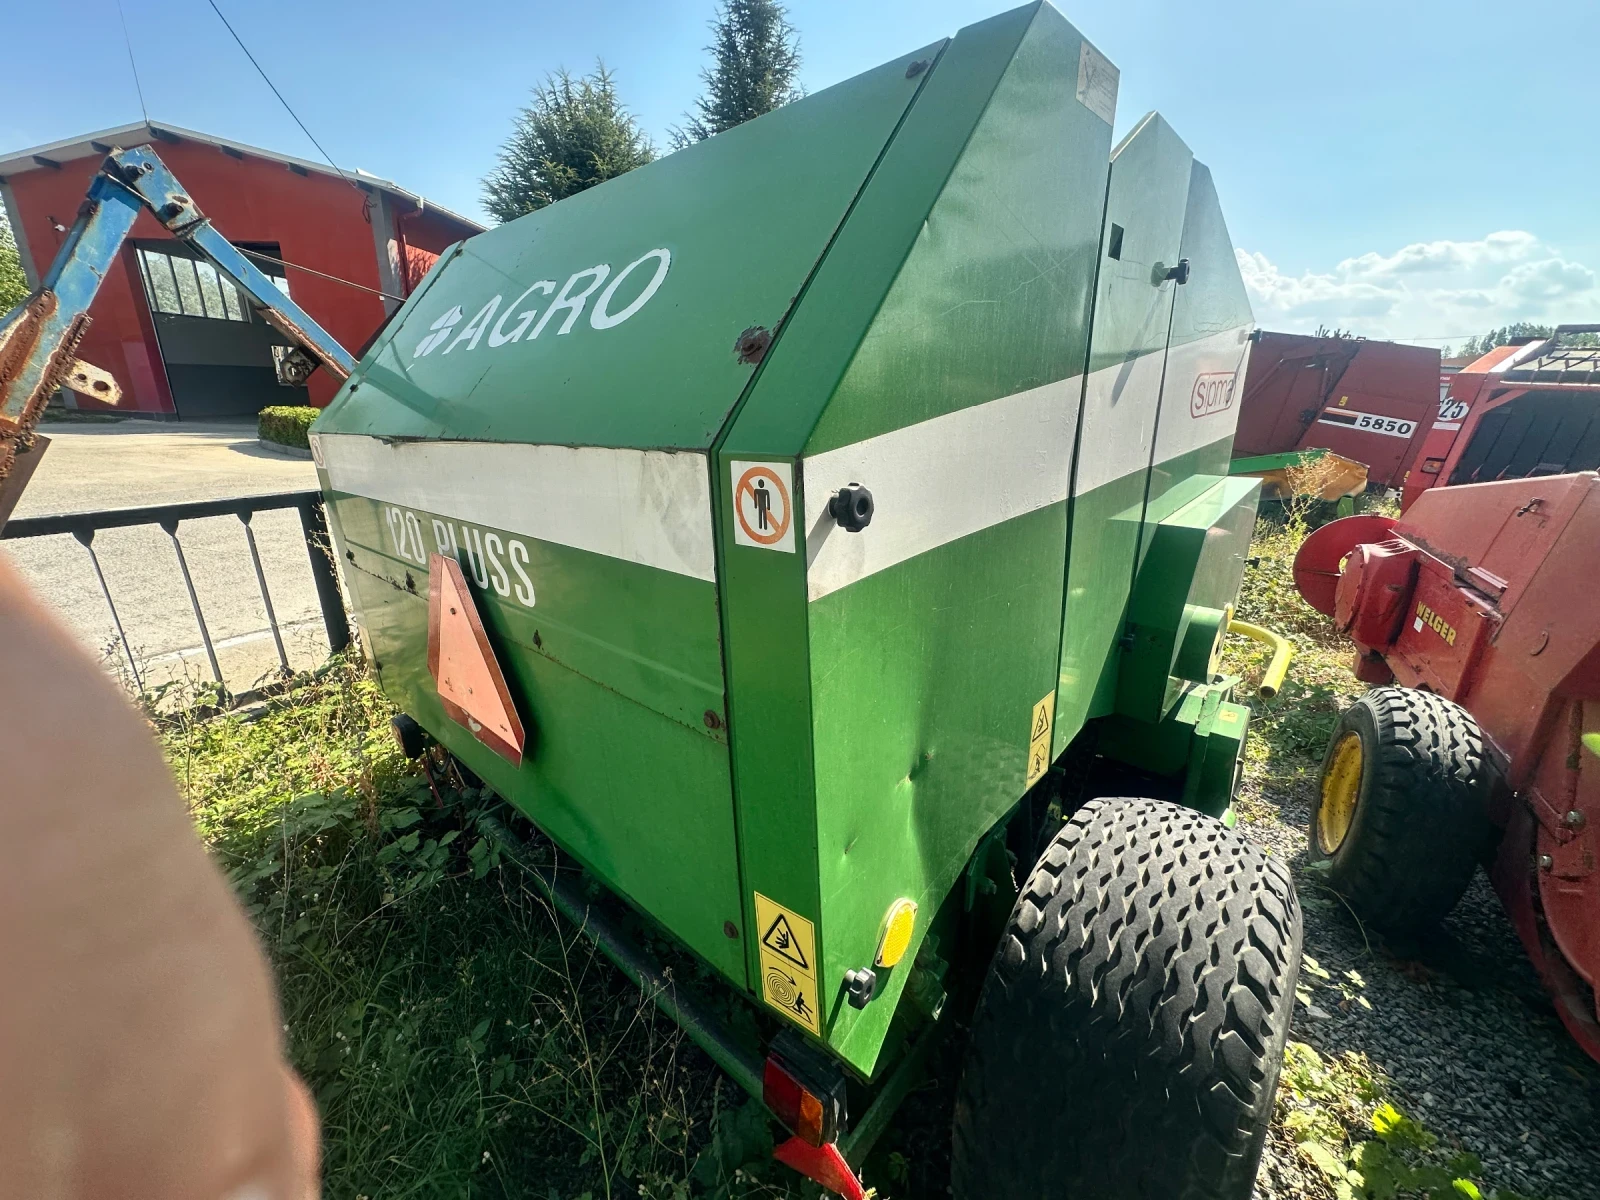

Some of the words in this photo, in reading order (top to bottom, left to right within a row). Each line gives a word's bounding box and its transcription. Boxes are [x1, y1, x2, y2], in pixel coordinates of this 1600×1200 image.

[442, 248, 671, 355] AGRO
[1360, 416, 1412, 434] 5850
[1440, 400, 1464, 418] 25
[385, 507, 426, 565] 120
[1416, 601, 1457, 647] WELGER
